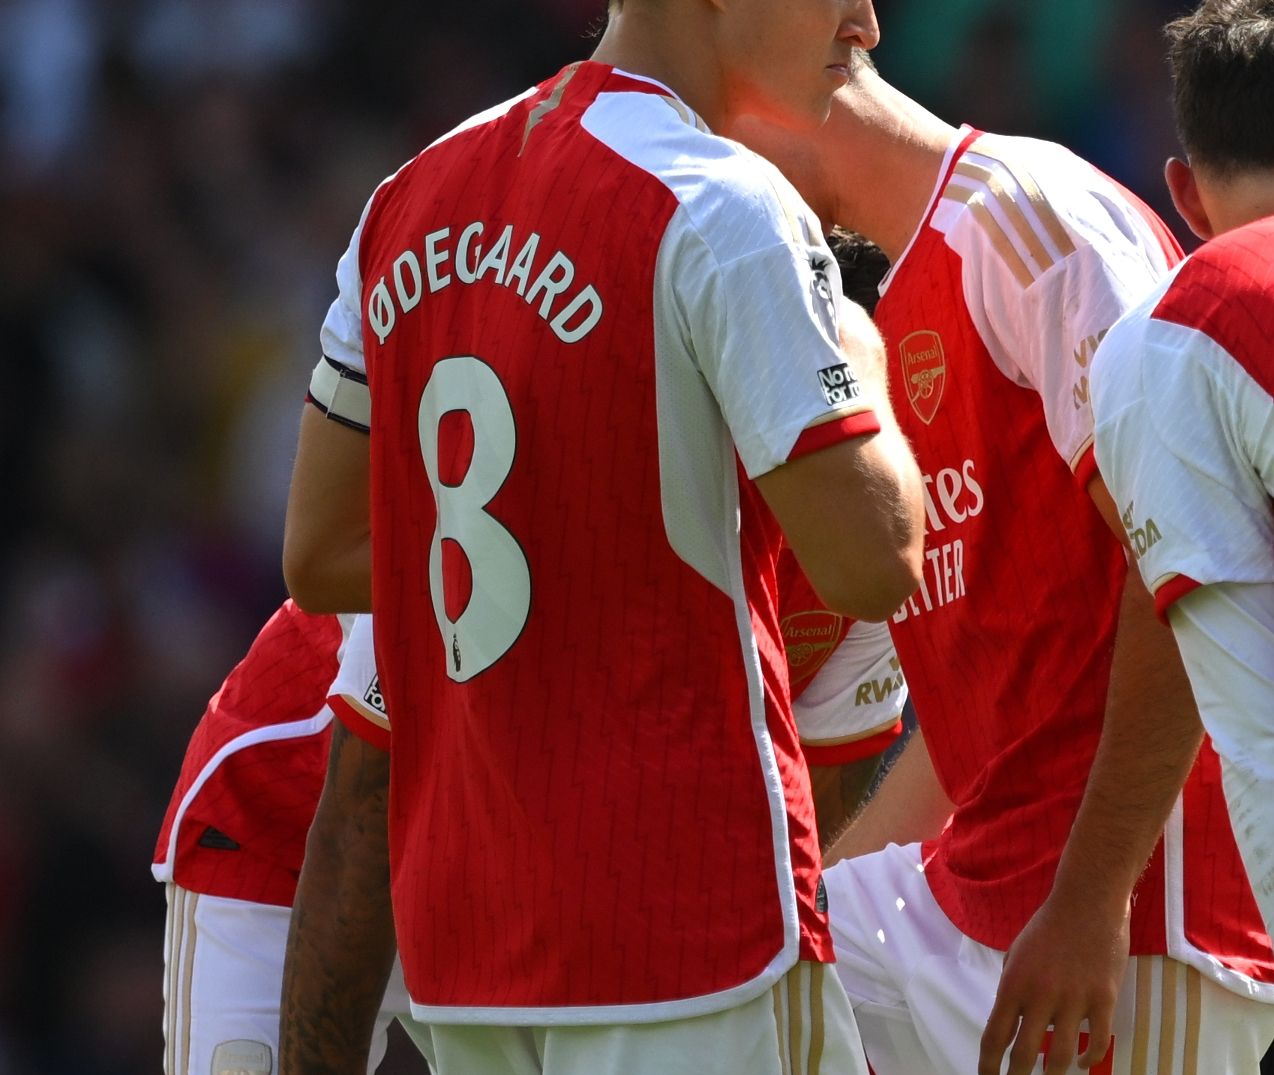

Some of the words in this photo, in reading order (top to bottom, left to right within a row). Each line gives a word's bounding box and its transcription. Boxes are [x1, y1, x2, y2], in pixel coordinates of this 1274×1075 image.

[368, 221, 604, 345] ØDEGAARD
[818, 368, 845, 387] No
[906, 343, 938, 364] Arsenal
[417, 355, 532, 683] 8
